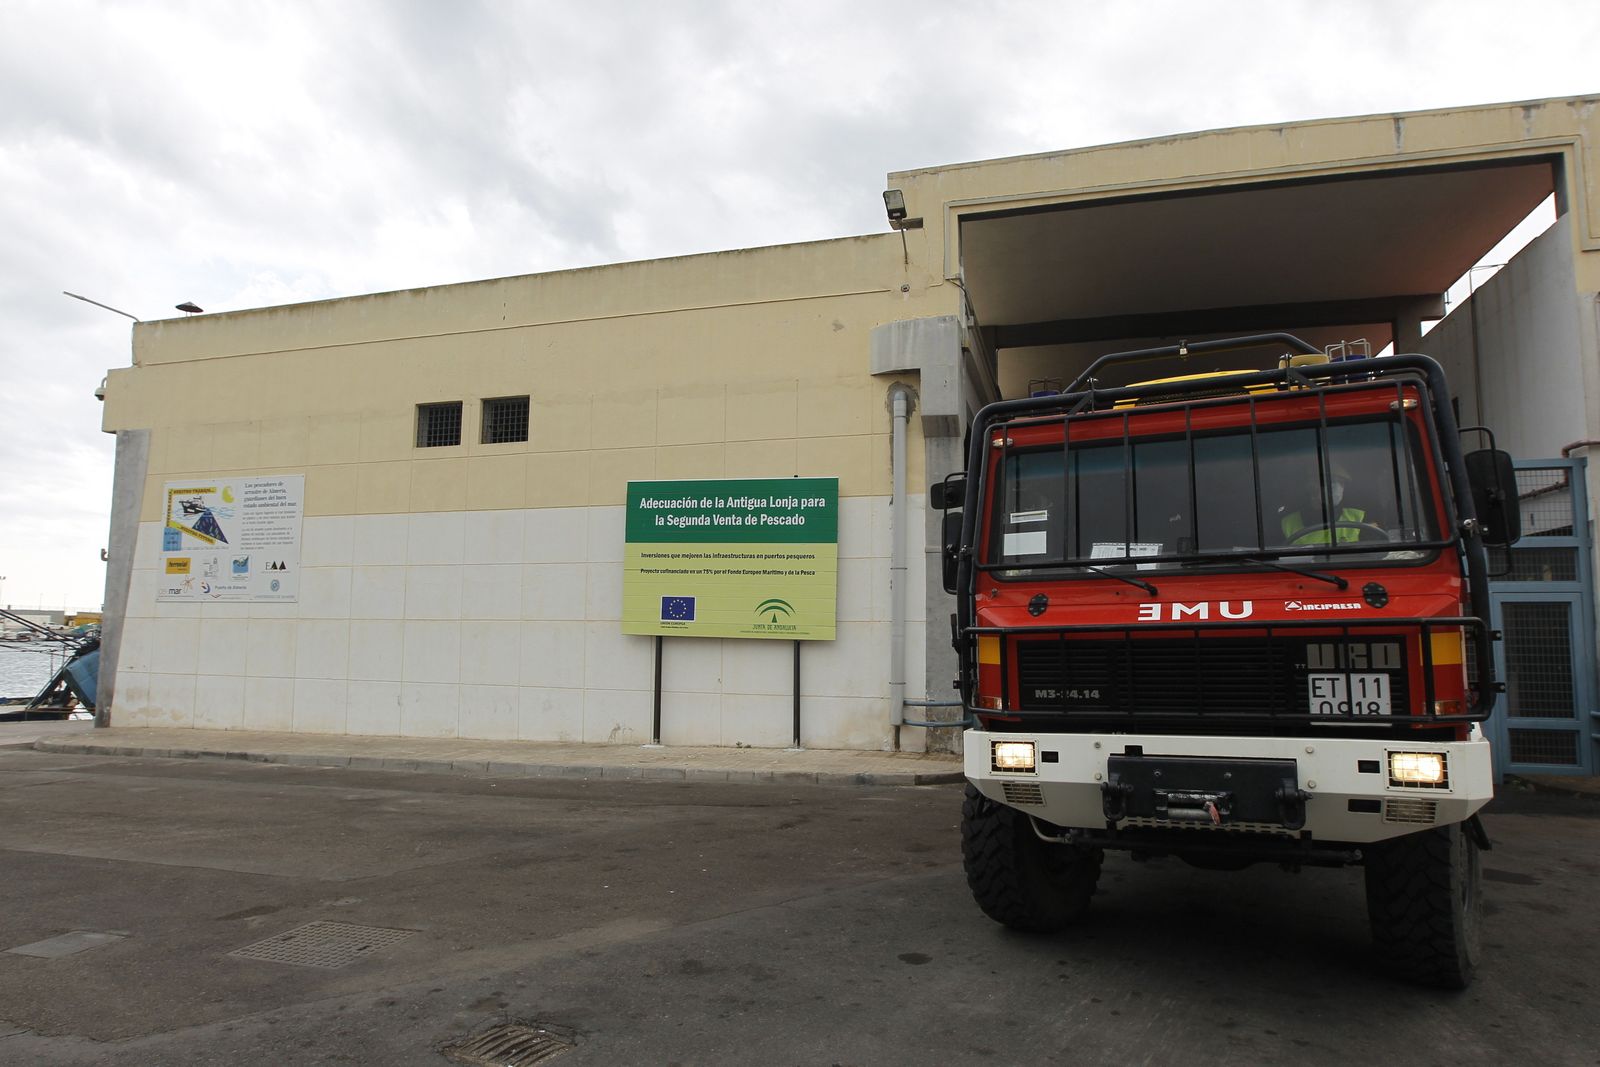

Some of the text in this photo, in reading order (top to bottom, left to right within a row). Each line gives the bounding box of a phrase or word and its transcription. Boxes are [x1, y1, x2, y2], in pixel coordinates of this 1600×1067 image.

[640, 496, 825, 510] Adecuación de la Antigua Lonja para
[655, 514, 805, 528] la Segunda Venta de Pescado
[1311, 677, 1382, 698] ET 11
